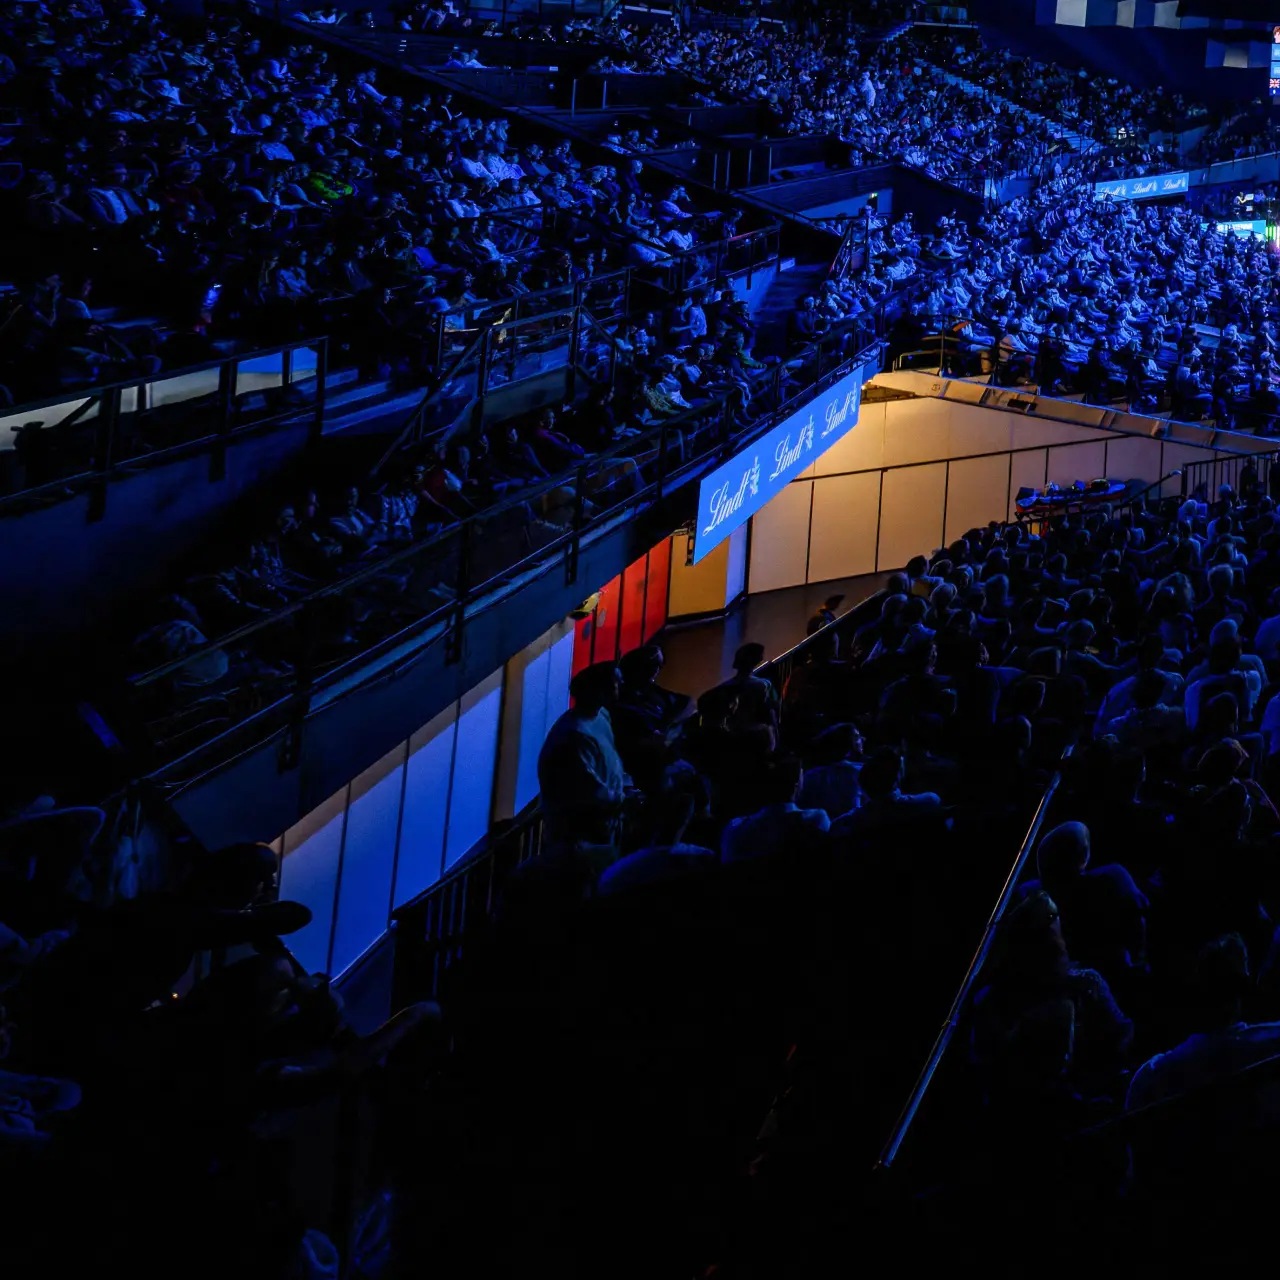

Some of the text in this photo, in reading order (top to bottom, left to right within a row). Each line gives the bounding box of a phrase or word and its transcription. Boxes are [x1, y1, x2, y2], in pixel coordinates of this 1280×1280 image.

[702, 392, 852, 536] Lindt Lindt Lindt
